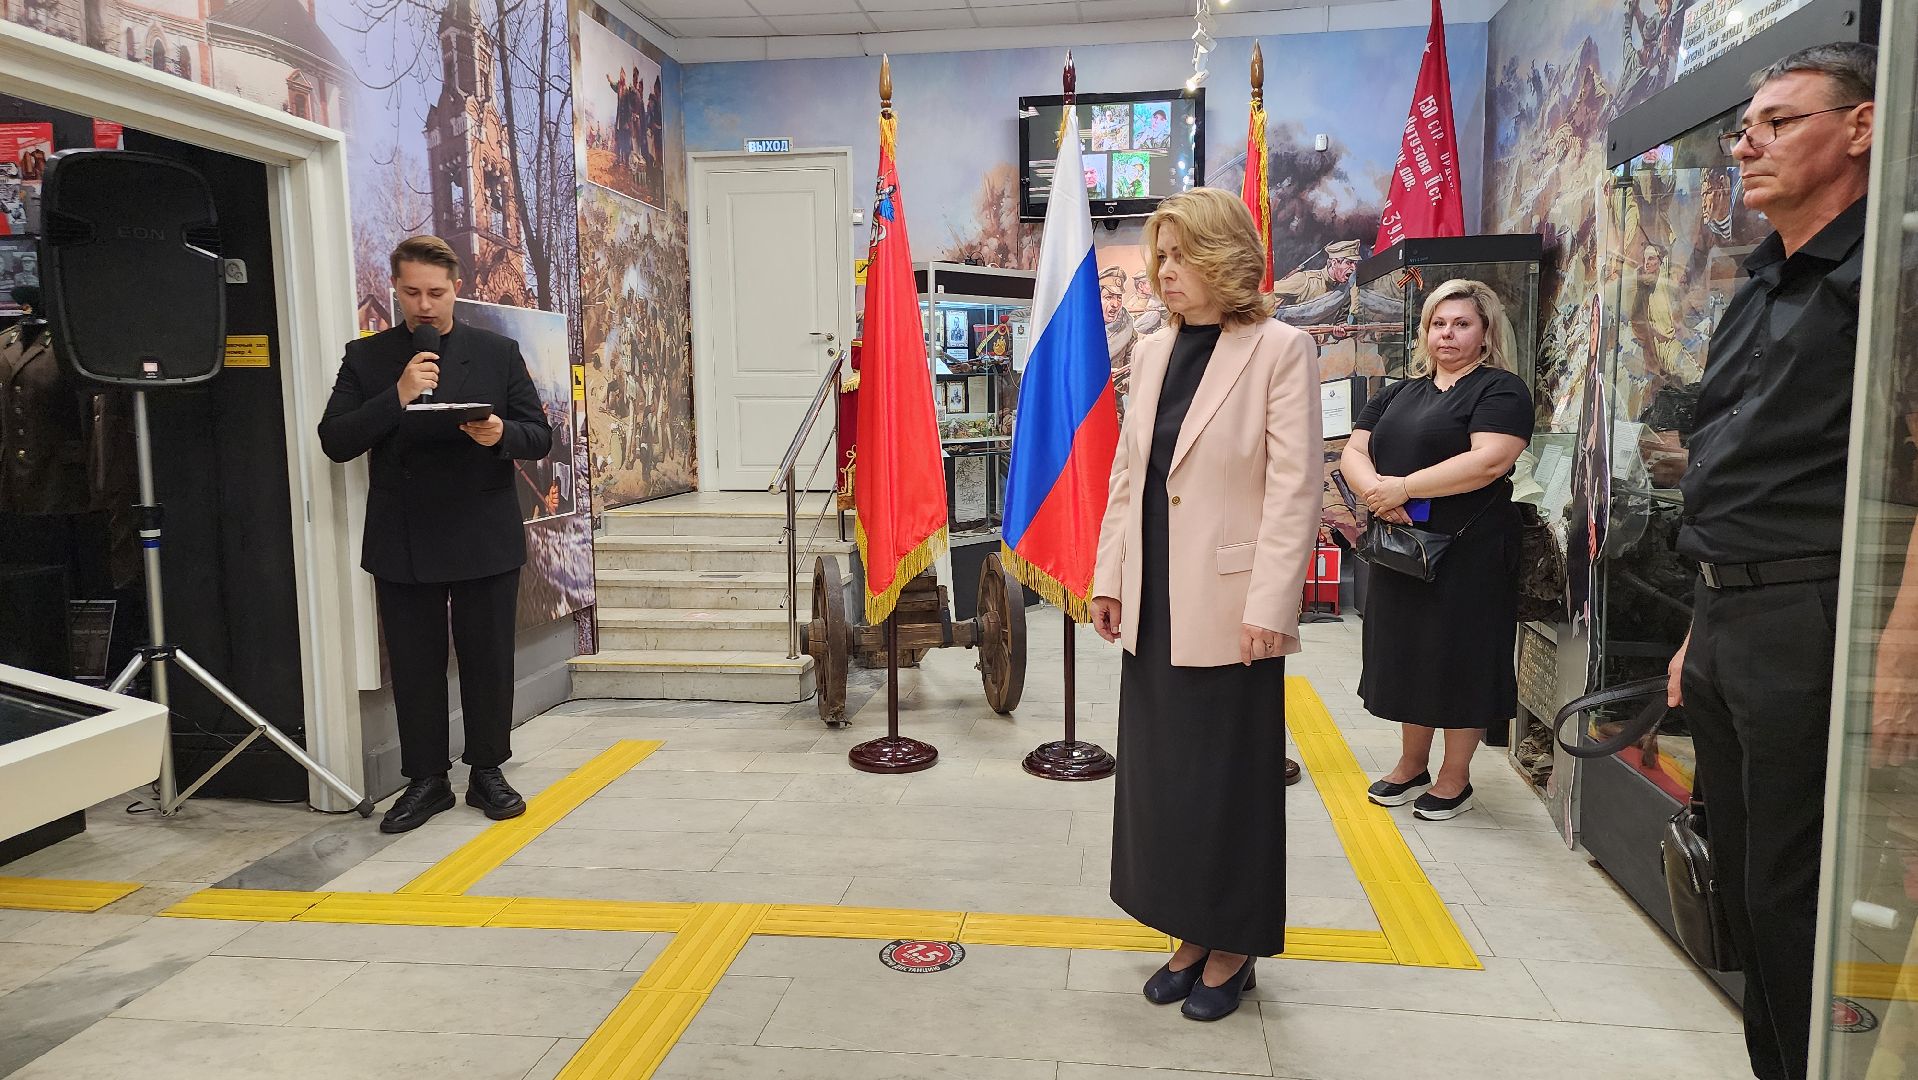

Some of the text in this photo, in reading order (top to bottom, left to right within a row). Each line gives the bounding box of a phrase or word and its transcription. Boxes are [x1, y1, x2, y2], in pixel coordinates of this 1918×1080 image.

[1418, 94, 1439, 119] 150
[748, 140, 789, 153] ВЫХОД
[117, 226, 165, 241] EON
[891, 963, 941, 973] ДИСТАНЦИЮ
